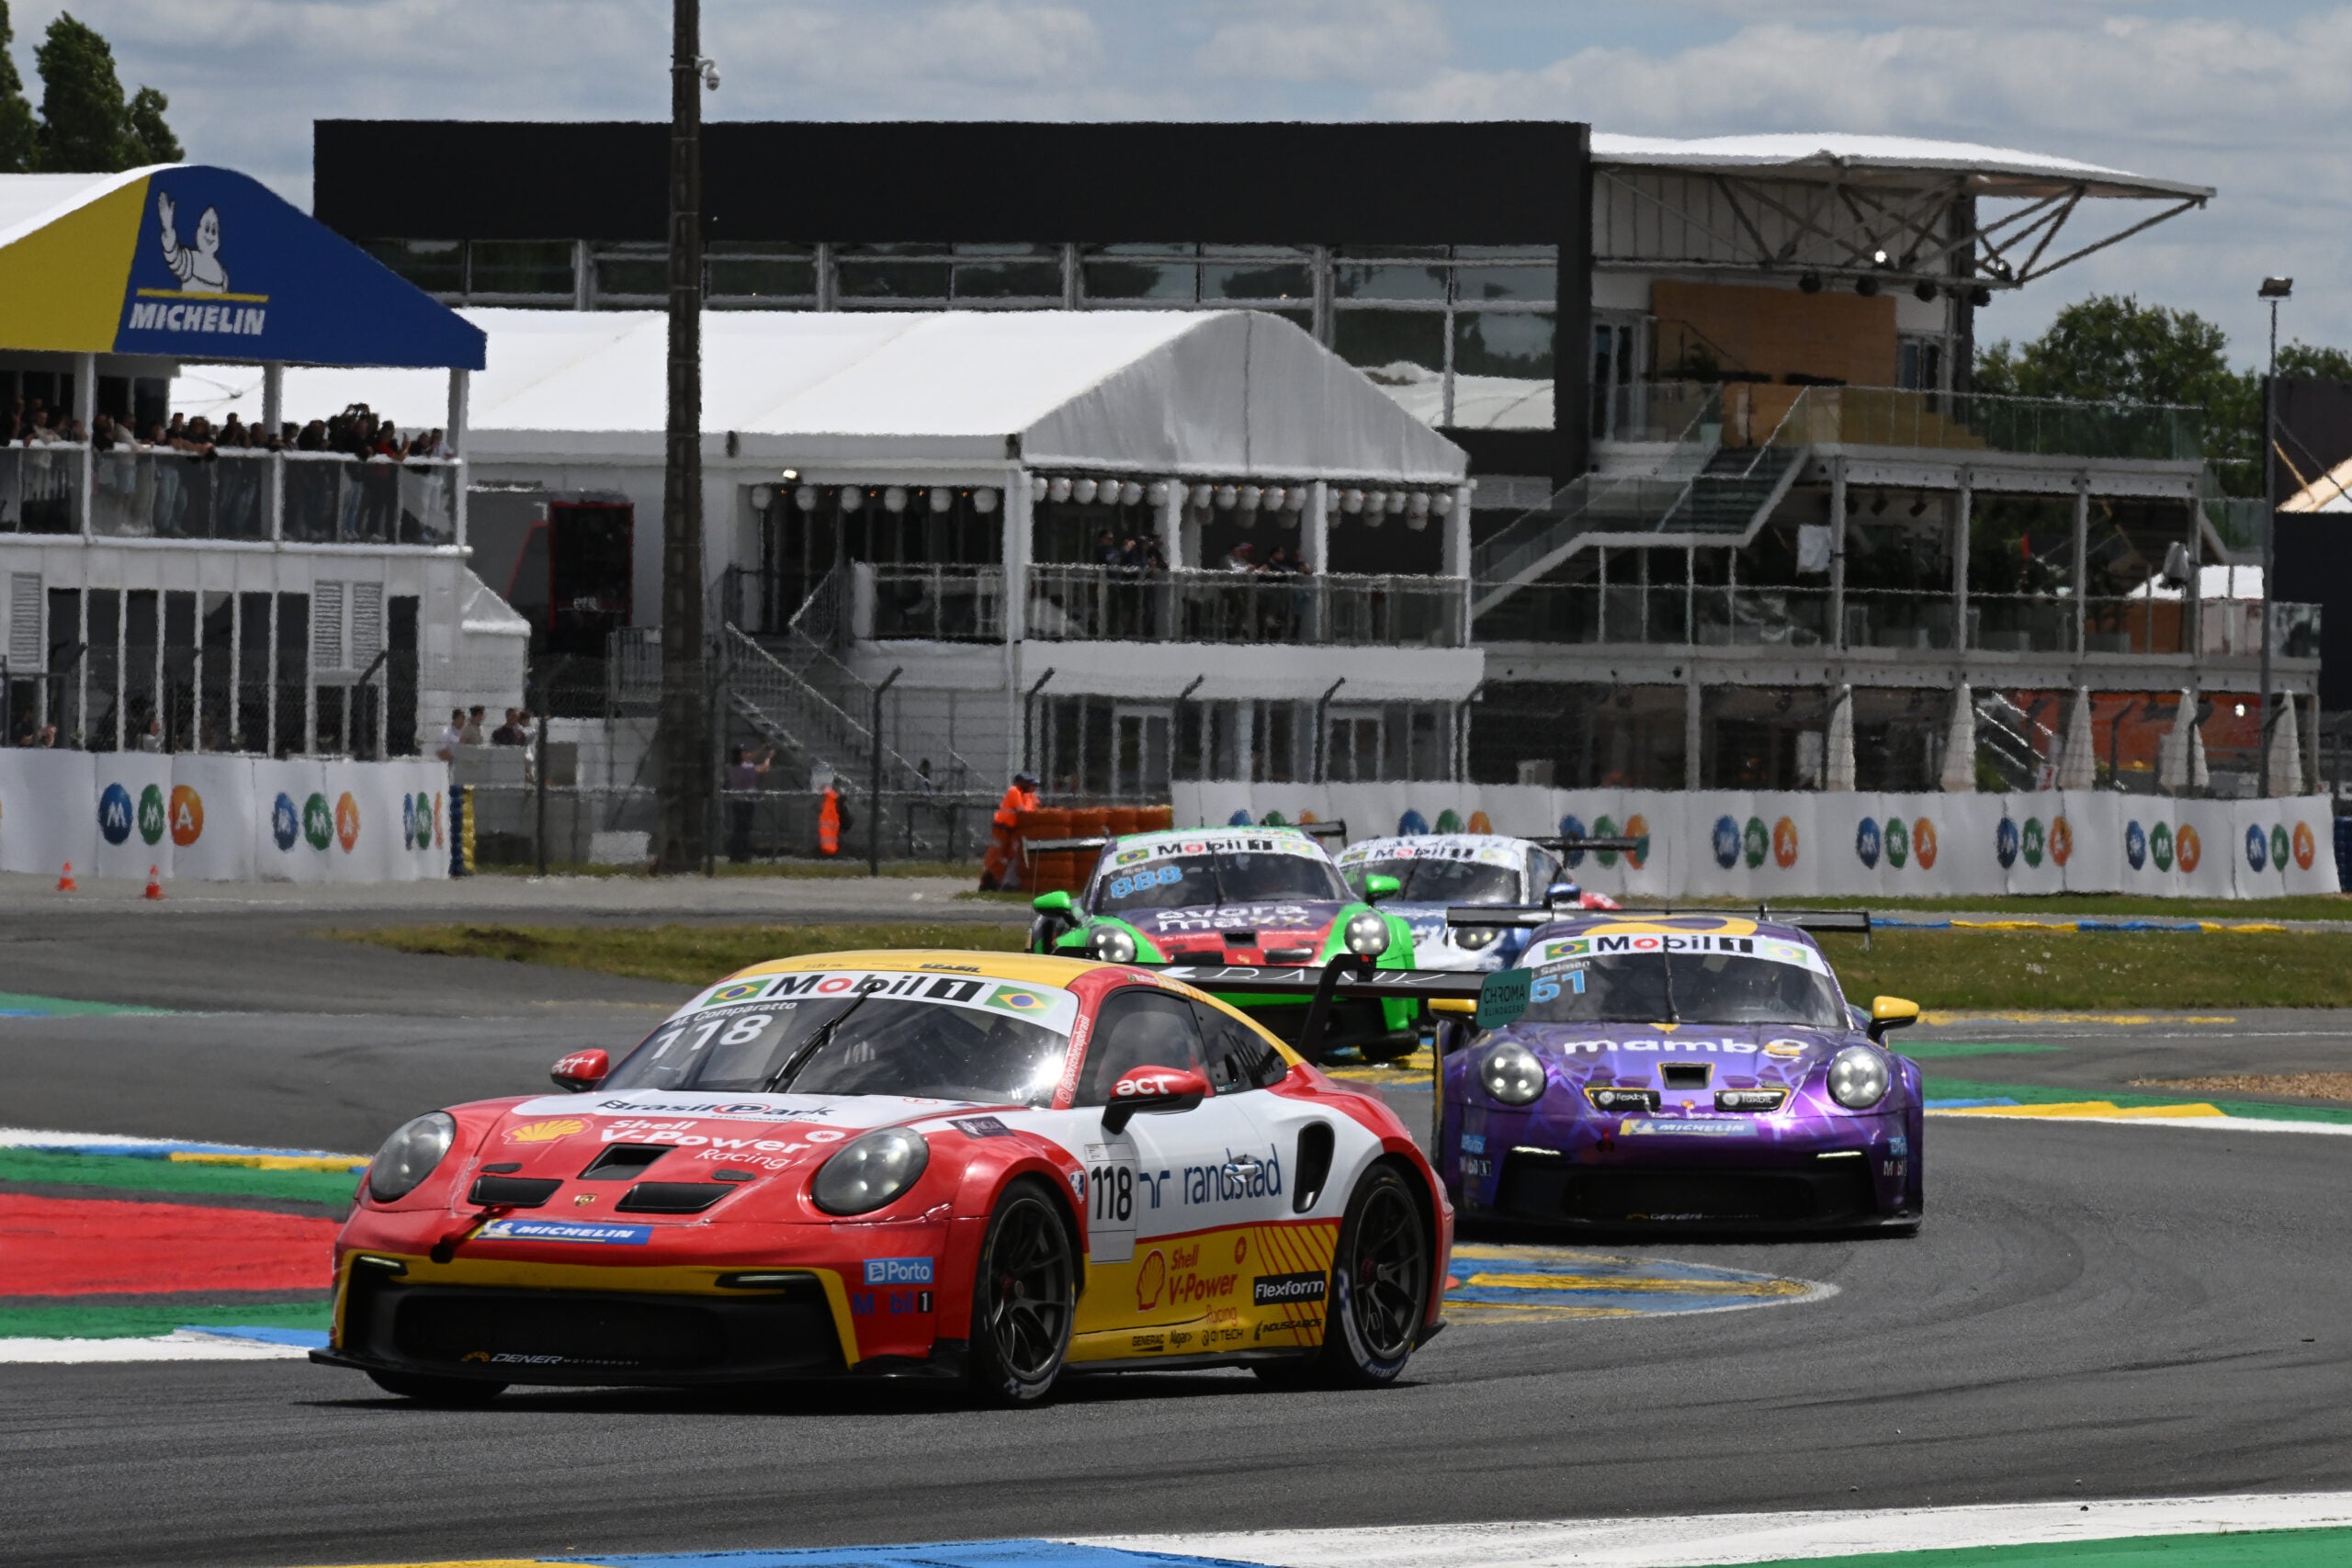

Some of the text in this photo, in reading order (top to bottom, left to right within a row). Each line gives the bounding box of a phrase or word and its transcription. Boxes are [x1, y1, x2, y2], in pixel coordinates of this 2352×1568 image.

[129, 303, 266, 335] MICHELIN
[107, 801, 194, 830] MMA
[1157, 840, 1240, 855] Mobil
[1110, 866, 1182, 898] 888
[1597, 935, 1711, 952] Mobil
[766, 974, 928, 997] Mobil
[1484, 985, 1525, 1004] CHROMA
[1530, 969, 1586, 1003] 51
[694, 1001, 797, 1022] Comparatto
[650, 1014, 774, 1060] 118
[1564, 1038, 1809, 1061] mambo
[1116, 1077, 1170, 1096] act
[606, 1120, 698, 1131] Shell
[1657, 1122, 1745, 1133] MICHELIN
[601, 1129, 812, 1154] V-Power
[695, 1148, 791, 1169] Racing
[1091, 1166, 1132, 1221] 118
[515, 1225, 636, 1238] MICHELIN
[1170, 1244, 1200, 1271] Shell
[888, 1261, 930, 1280] Porto
[1169, 1273, 1238, 1305] V-Power
[1255, 1280, 1325, 1299] Flexform
[853, 1291, 914, 1316] Mbil
[1205, 1303, 1238, 1326] Racing
[1132, 1334, 1164, 1347] GENERAC
[491, 1353, 563, 1364] DENER
